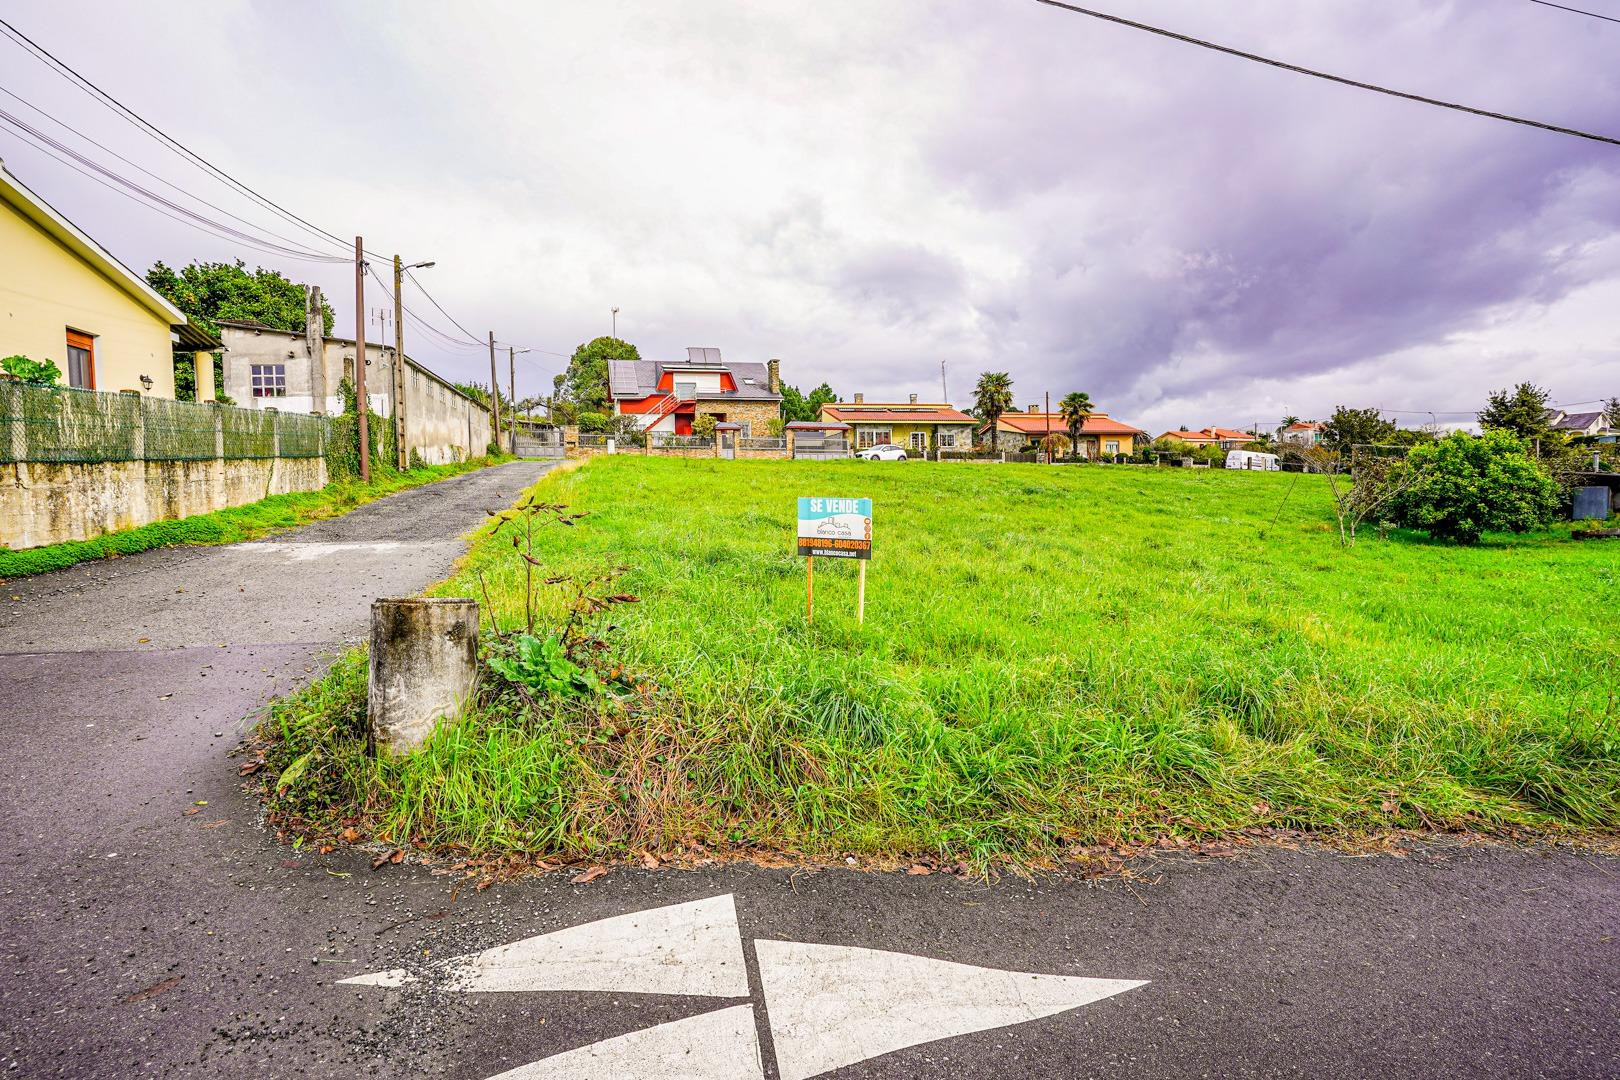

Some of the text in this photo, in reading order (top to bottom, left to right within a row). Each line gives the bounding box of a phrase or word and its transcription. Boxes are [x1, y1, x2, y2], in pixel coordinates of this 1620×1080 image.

[810, 499, 859, 513] SE VENDE
[816, 528, 836, 536] blanco
